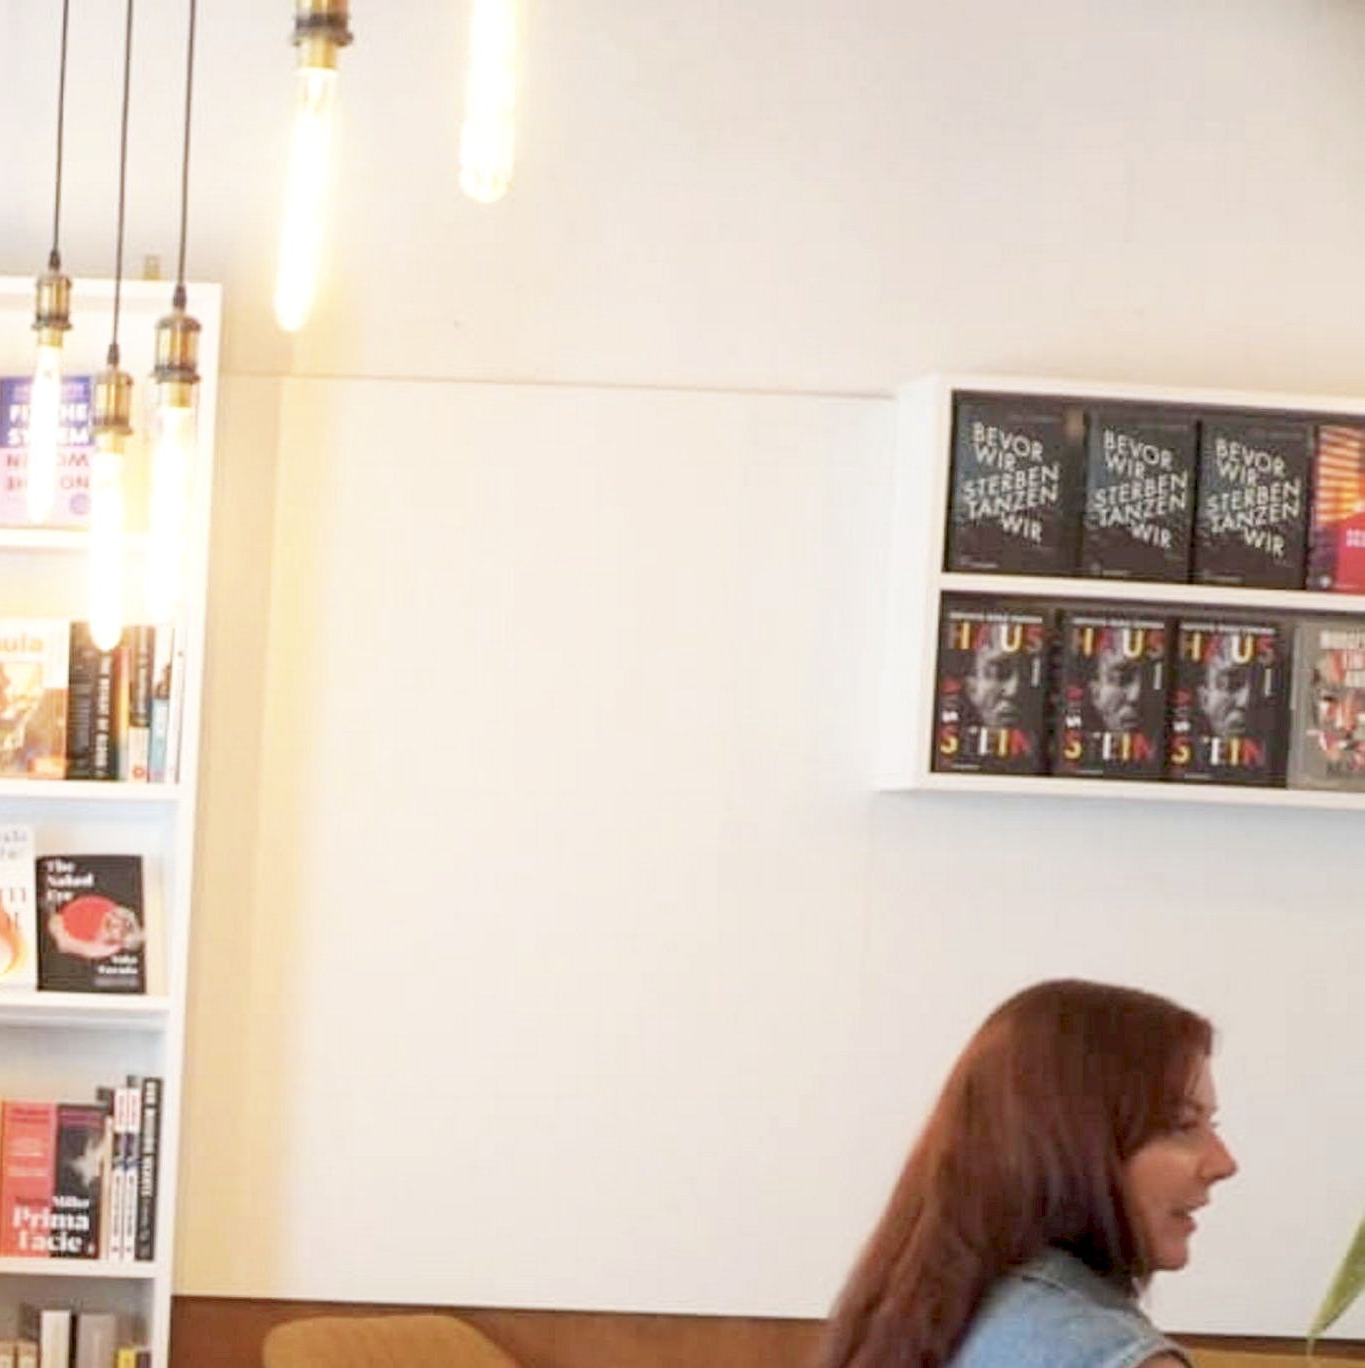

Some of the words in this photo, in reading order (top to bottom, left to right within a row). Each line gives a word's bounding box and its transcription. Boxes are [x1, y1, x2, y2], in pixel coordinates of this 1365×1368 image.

[972, 421, 1043, 460] BEVOR
[1103, 429, 1172, 469] BEVOR
[976, 446, 1017, 471] WIR
[1105, 454, 1146, 480] WIR
[1215, 438, 1286, 478] BEVOR
[964, 463, 1060, 501] STERBEN
[1094, 471, 1188, 509] STERBEN
[1218, 463, 1258, 487] WIR
[968, 484, 1059, 520] TANZEN
[1097, 493, 1186, 527] TANZEN
[1206, 478, 1301, 515] STERBEN
[1001, 516, 1042, 543] WIR
[1211, 501, 1300, 534] TANZEN
[1131, 523, 1171, 549] WIR
[1243, 530, 1284, 558] WIR
[11, 1207, 90, 1231] Prima
